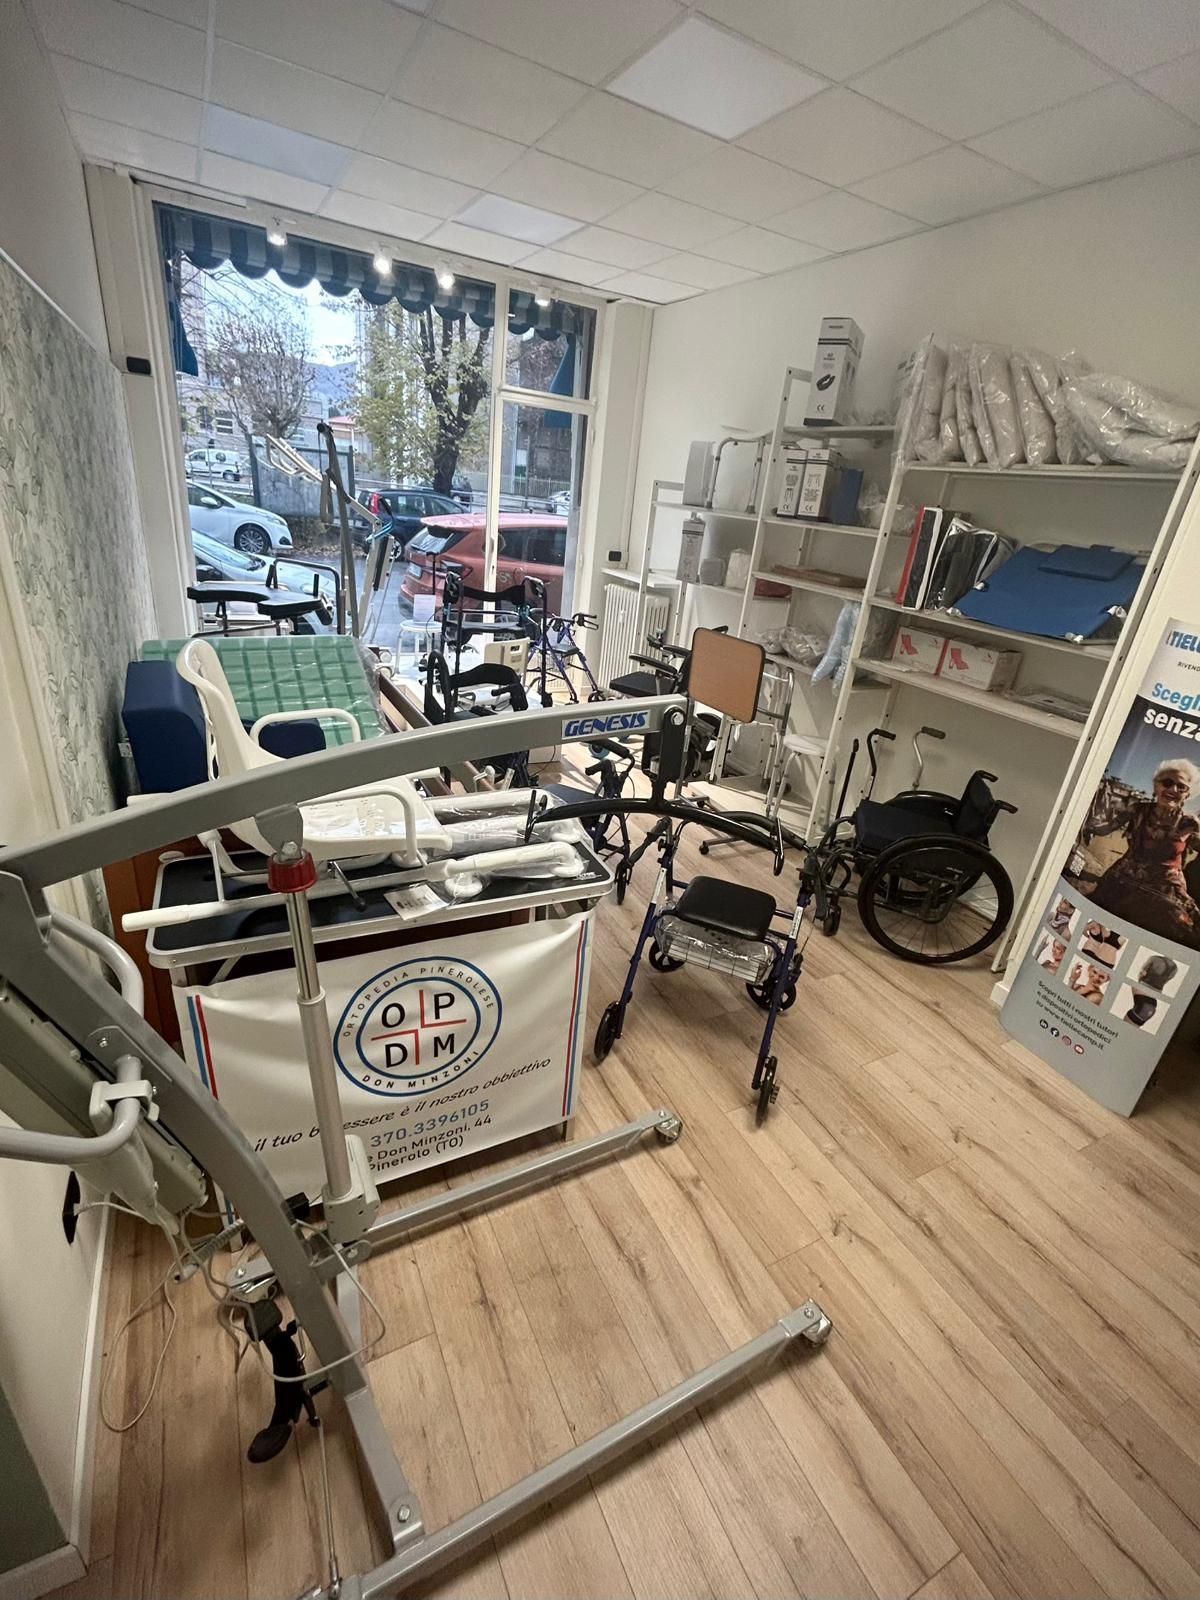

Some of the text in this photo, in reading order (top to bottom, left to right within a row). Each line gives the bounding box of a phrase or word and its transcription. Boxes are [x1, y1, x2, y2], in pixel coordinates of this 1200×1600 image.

[1170, 631, 1200, 653] TIEL
[1152, 682, 1200, 711] Scegl
[564, 712, 648, 736] GENESIS
[342, 966, 494, 1038] ORTOPEDIA PINEROLESE
[1073, 1017, 1112, 1045] ortopedici
[362, 1050, 479, 1089] DON MINZONI
[254, 1058, 551, 1152] il tuo bessere è il nostro obbiettivo
[370, 1099, 490, 1148] 370.3396105
[376, 1144, 407, 1161] Don
[411, 1122, 472, 1150] Minzoni,
[474, 1114, 492, 1129] 44
[435, 1135, 464, 1154] (TO)
